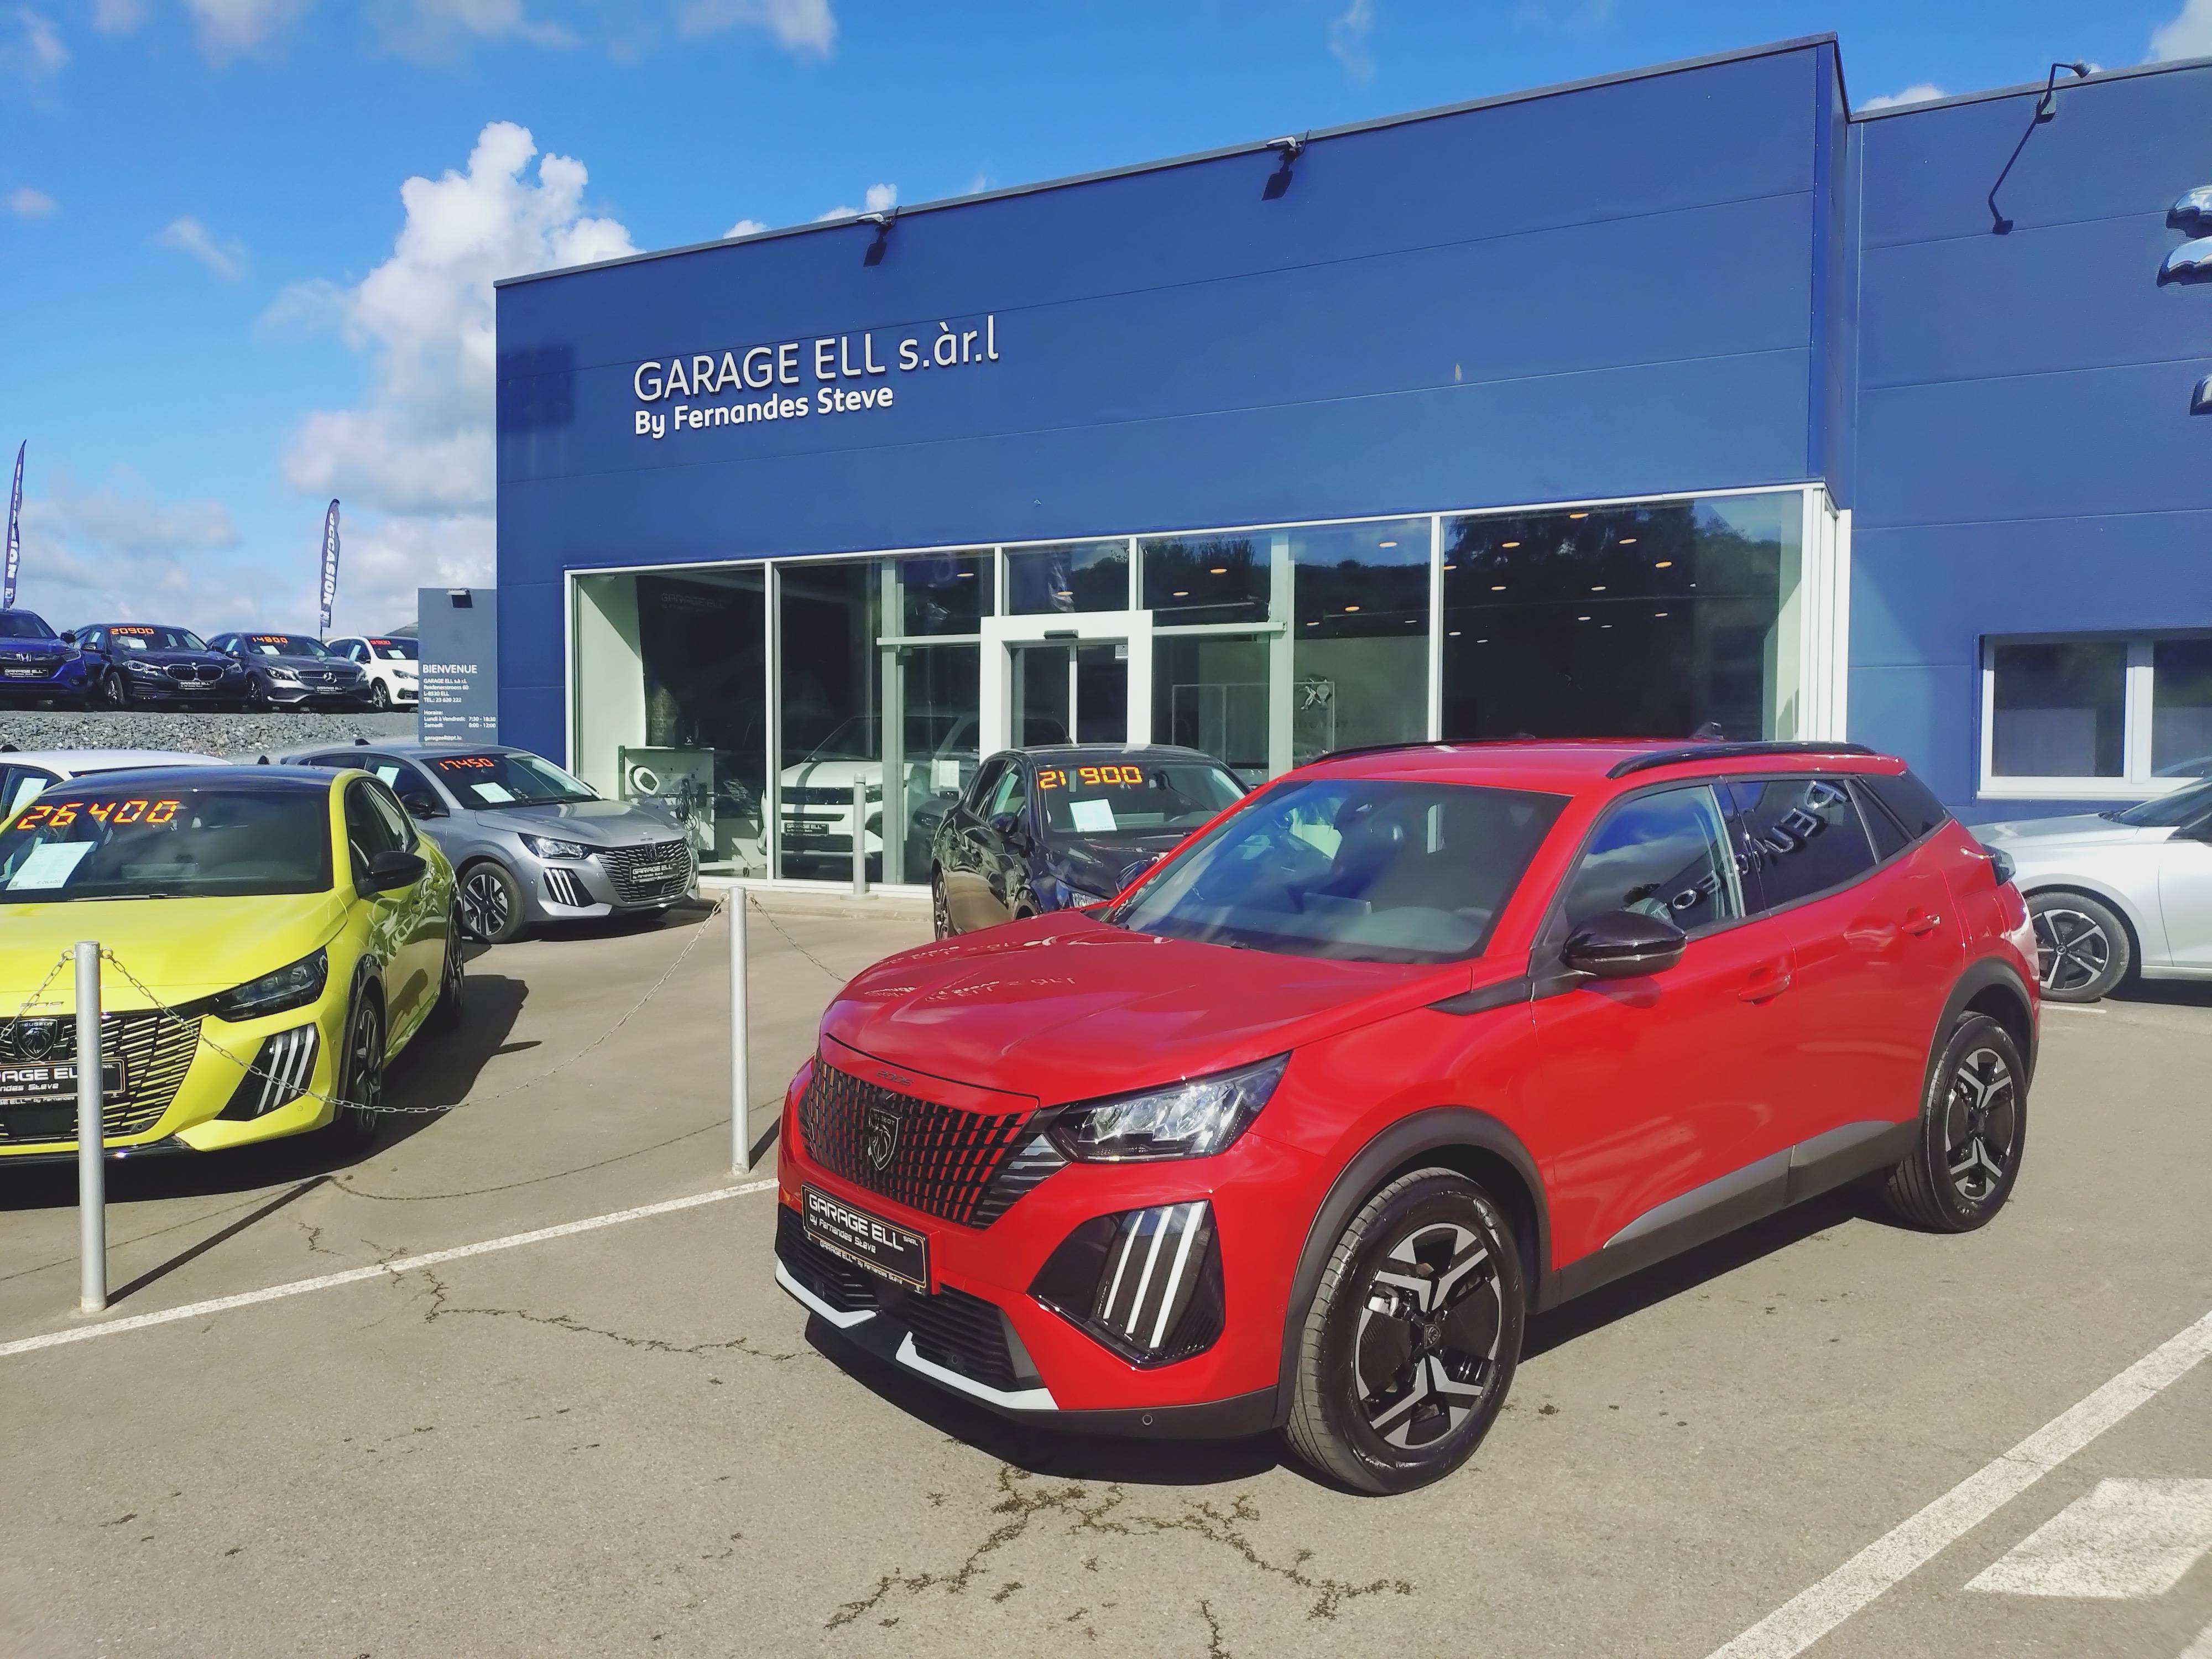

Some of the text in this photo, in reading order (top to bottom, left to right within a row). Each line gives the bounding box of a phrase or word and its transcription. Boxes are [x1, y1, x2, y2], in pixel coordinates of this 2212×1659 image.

[634, 314, 999, 401] GARAGE ELL s.àr.l
[635, 387, 894, 439] By Fernandes Steve
[322, 512, 336, 606] OCCASION
[422, 664, 478, 674] BIENVENUE
[438, 758, 495, 770] 17450
[1039, 765, 1143, 789] 21 900
[809, 1193, 869, 1237] GARAGE
[871, 1223, 904, 1253] ELL
[810, 1213, 876, 1254] by Fernandes Steve
